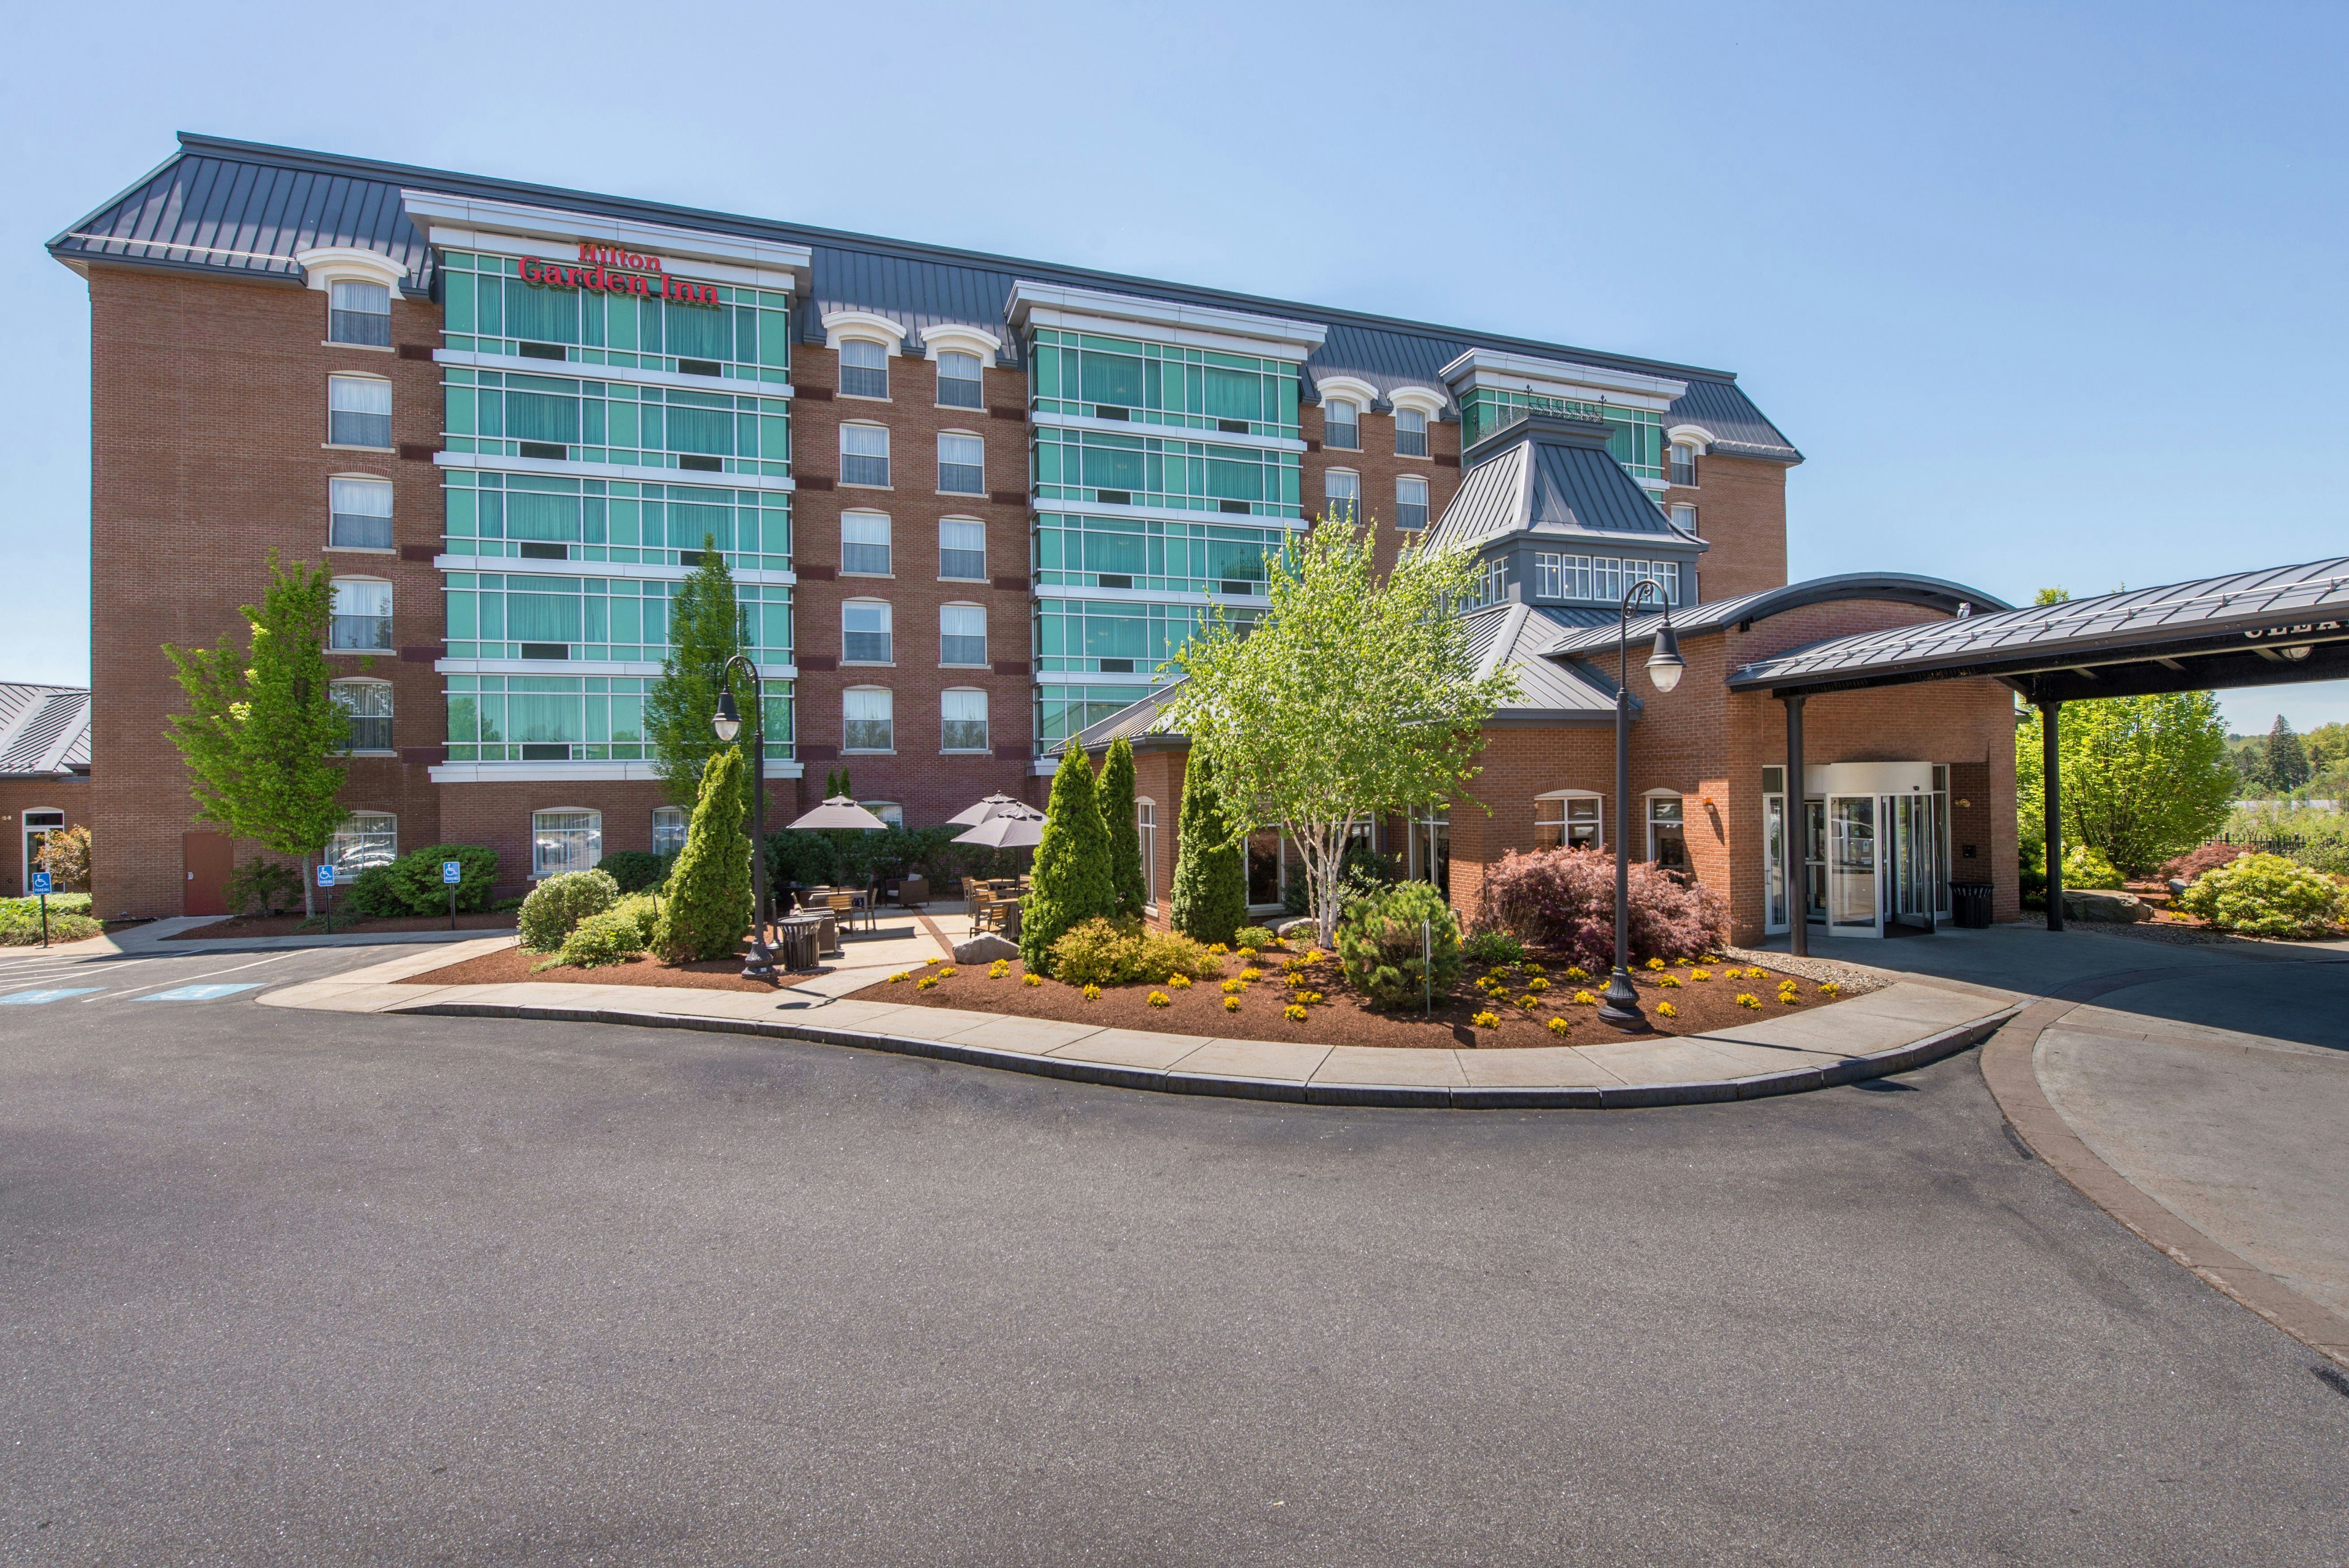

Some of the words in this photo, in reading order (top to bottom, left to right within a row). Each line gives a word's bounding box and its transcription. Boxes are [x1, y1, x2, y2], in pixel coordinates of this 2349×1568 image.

[578, 242, 662, 271] Hilton
[518, 256, 651, 295] Garden
[660, 273, 720, 304] Inn
